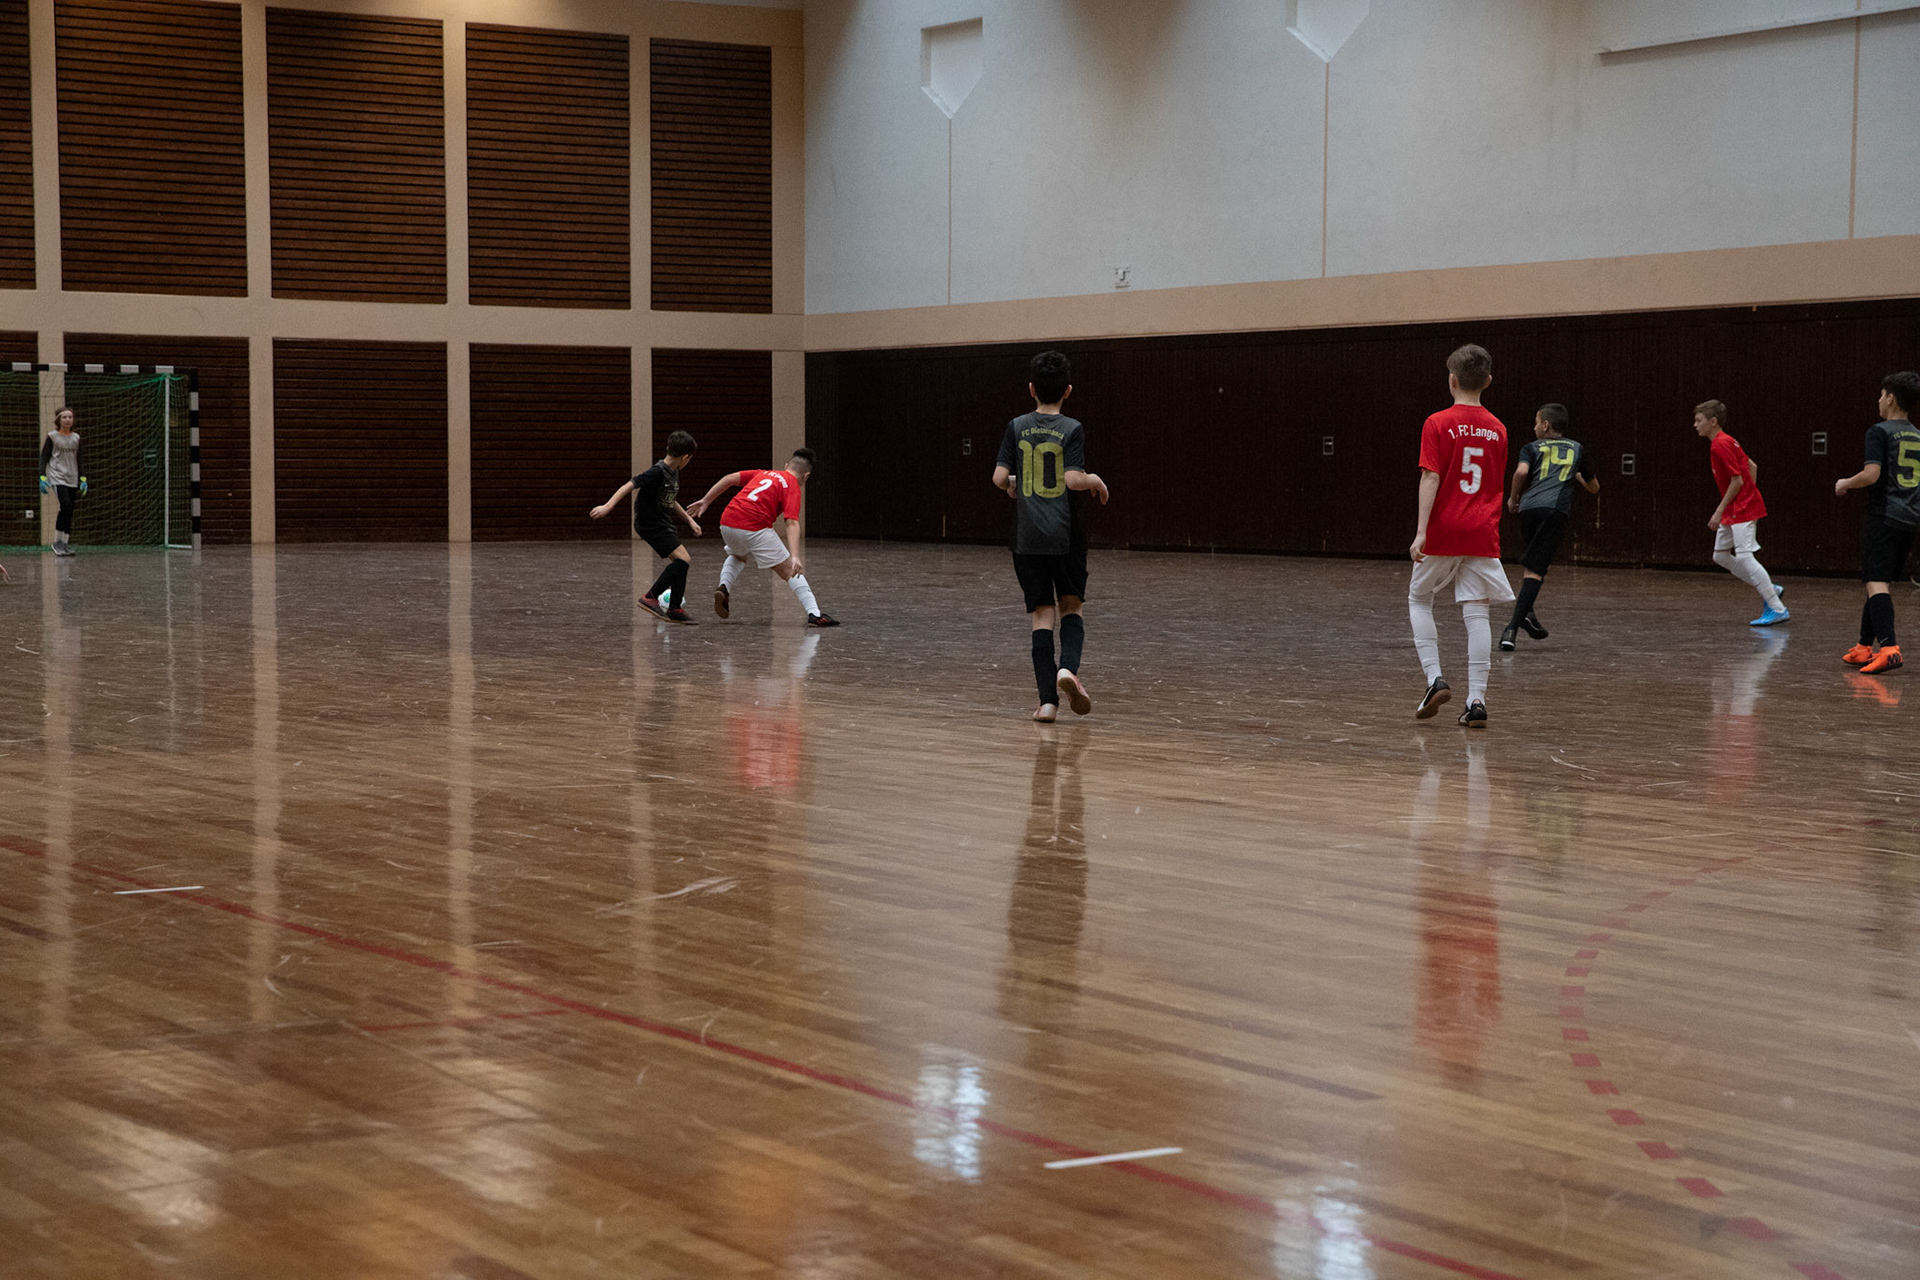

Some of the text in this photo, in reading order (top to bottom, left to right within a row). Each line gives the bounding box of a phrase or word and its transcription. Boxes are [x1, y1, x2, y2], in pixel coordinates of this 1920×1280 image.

[1021, 428, 1030, 438] FC
[1458, 424, 1469, 436] FC
[1018, 440, 1066, 498] 10
[1459, 446, 1484, 495] 5
[1539, 445, 1575, 482] 14
[1897, 440, 1920, 488] 5
[747, 478, 773, 502] 2
